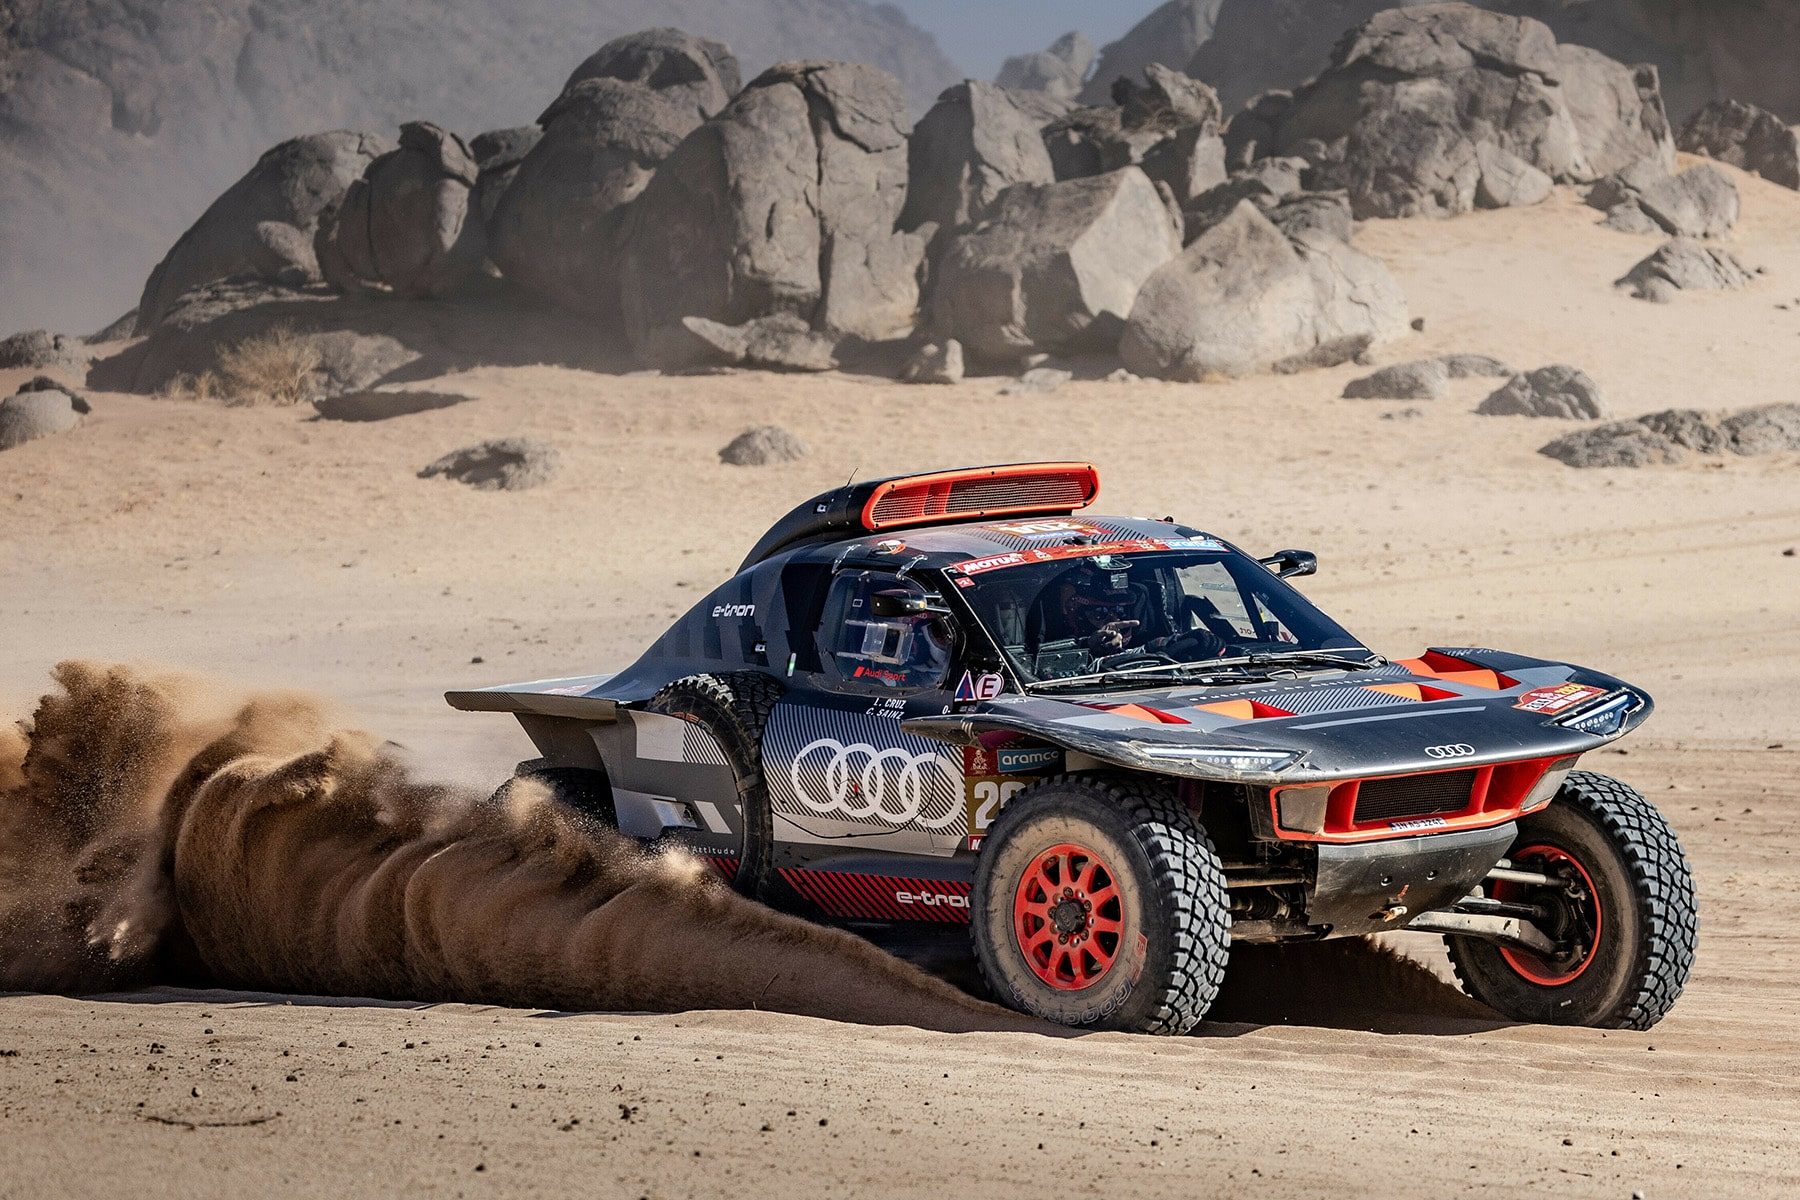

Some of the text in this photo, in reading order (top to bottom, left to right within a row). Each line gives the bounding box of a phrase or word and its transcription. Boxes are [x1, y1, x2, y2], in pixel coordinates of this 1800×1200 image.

[963, 553, 1021, 572] MOTUL
[712, 603, 756, 617] e-tron
[864, 668, 907, 681] Audi Sport
[981, 678, 997, 698] E
[873, 697, 906, 710] L. CRUZ
[866, 707, 905, 720] C. SAINZ
[1002, 751, 1059, 766] aramco
[692, 845, 735, 855] Attitude
